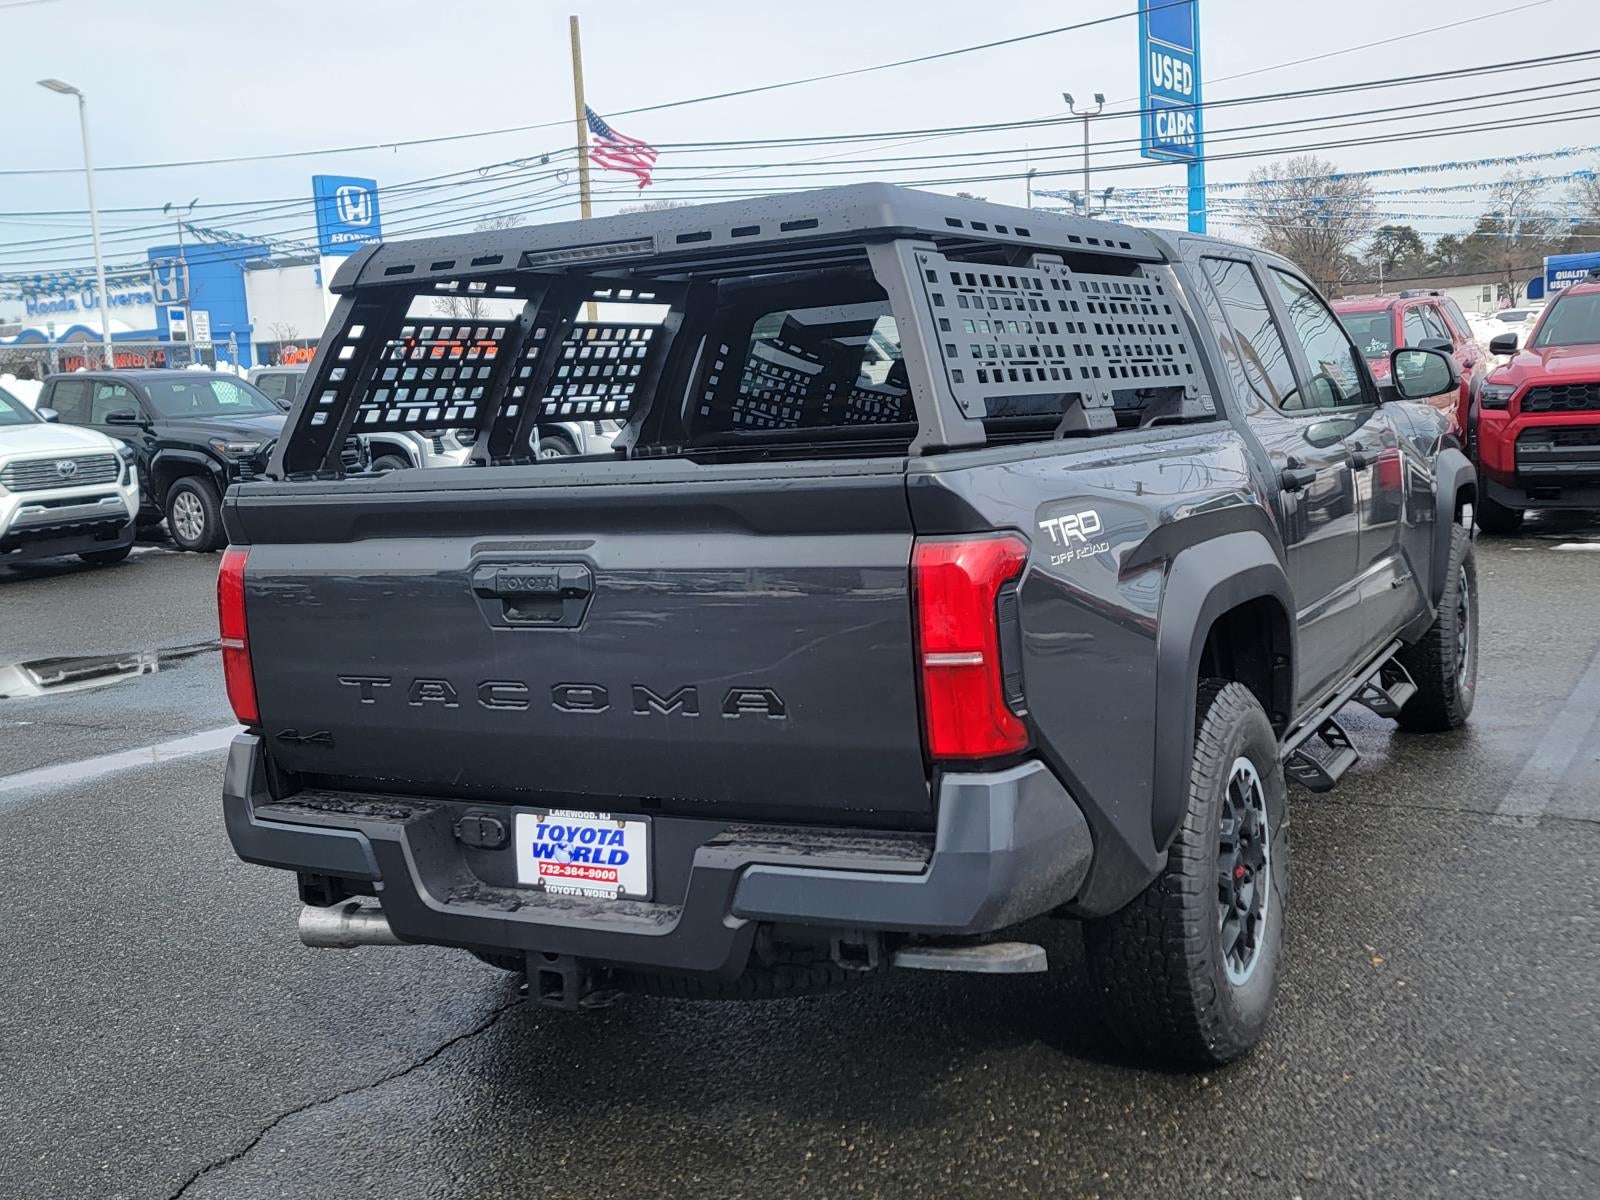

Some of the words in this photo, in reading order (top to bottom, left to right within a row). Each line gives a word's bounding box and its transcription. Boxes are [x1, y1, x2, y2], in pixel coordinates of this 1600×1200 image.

[1151, 51, 1193, 96] USED
[1156, 109, 1195, 148] CARS
[331, 233, 381, 245] HONDA
[1555, 269, 1589, 280] QUALITY
[1550, 280, 1571, 290] USED
[1039, 510, 1101, 547] TRD
[1051, 551, 1074, 566] OFF
[1076, 541, 1110, 560] ROAD
[500, 576, 556, 591] TOYOTA
[337, 674, 787, 720] TACOMA
[599, 811, 611, 820] NJ
[536, 823, 625, 847] TOYOTA
[540, 864, 616, 880] 732-364-9000
[544, 885, 582, 896] TOYOTA
[583, 887, 618, 900] WORLD
